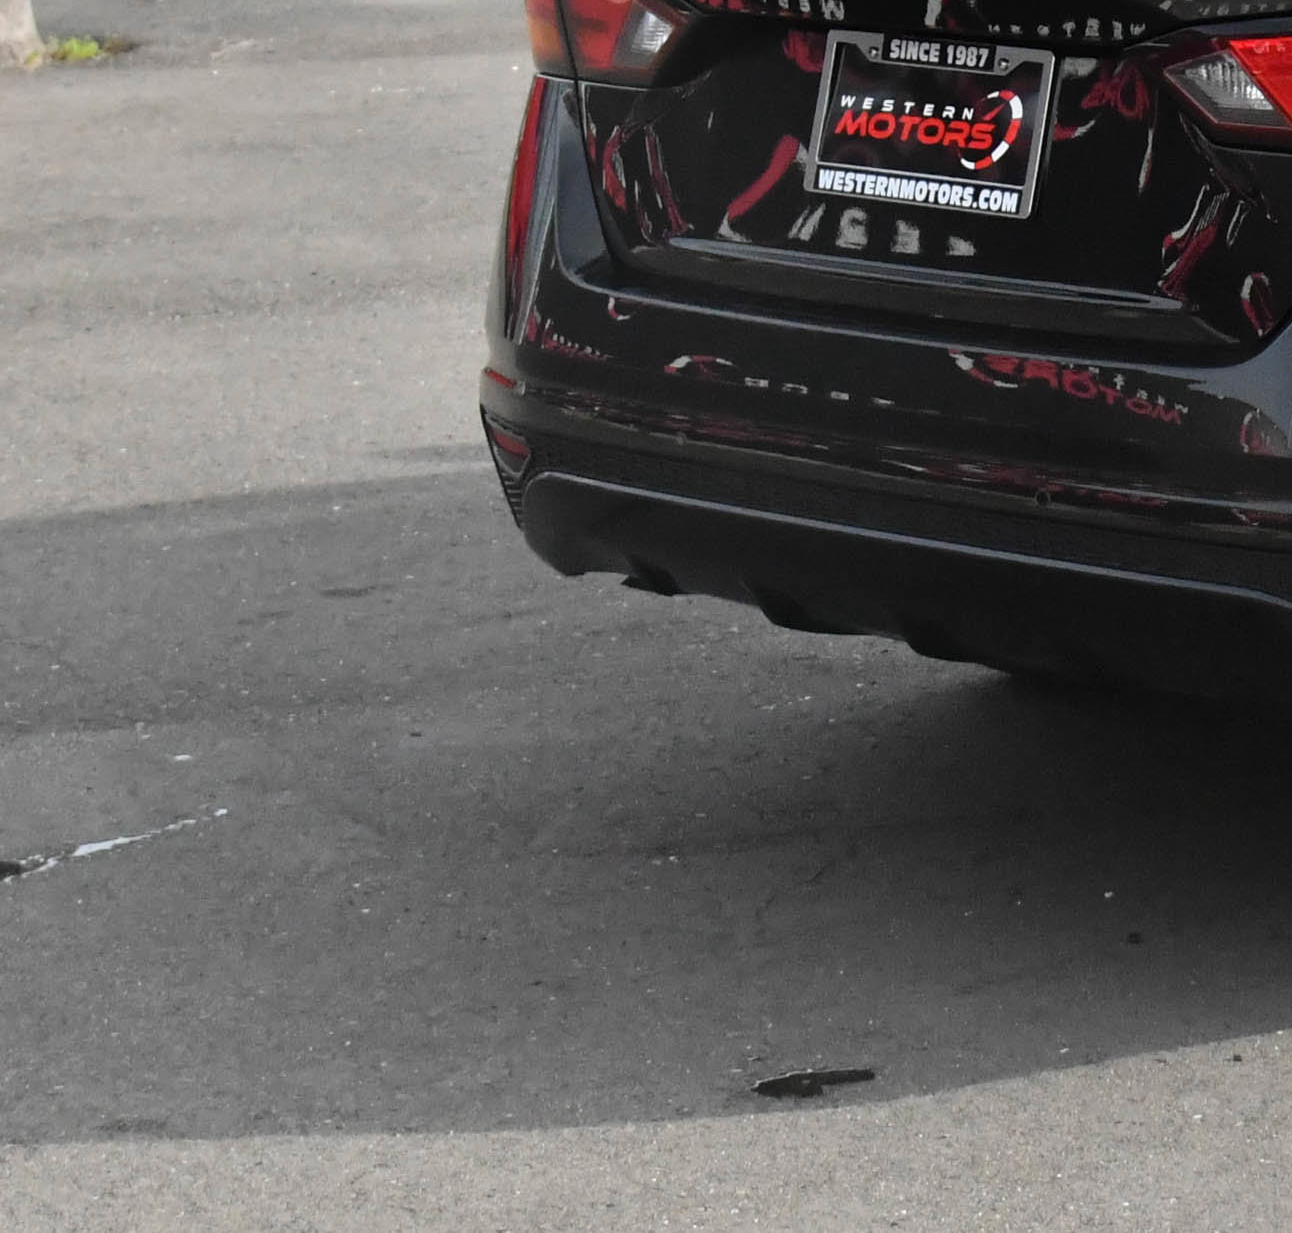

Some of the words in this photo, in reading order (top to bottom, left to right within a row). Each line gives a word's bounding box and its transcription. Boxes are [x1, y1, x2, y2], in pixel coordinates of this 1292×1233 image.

[889, 38, 941, 63] SINCE
[946, 44, 990, 68] 1987
[840, 94, 975, 121] WESTERN
[834, 109, 997, 150] MOTORS
[818, 168, 1019, 213] WESTERNMOTORS.COM
